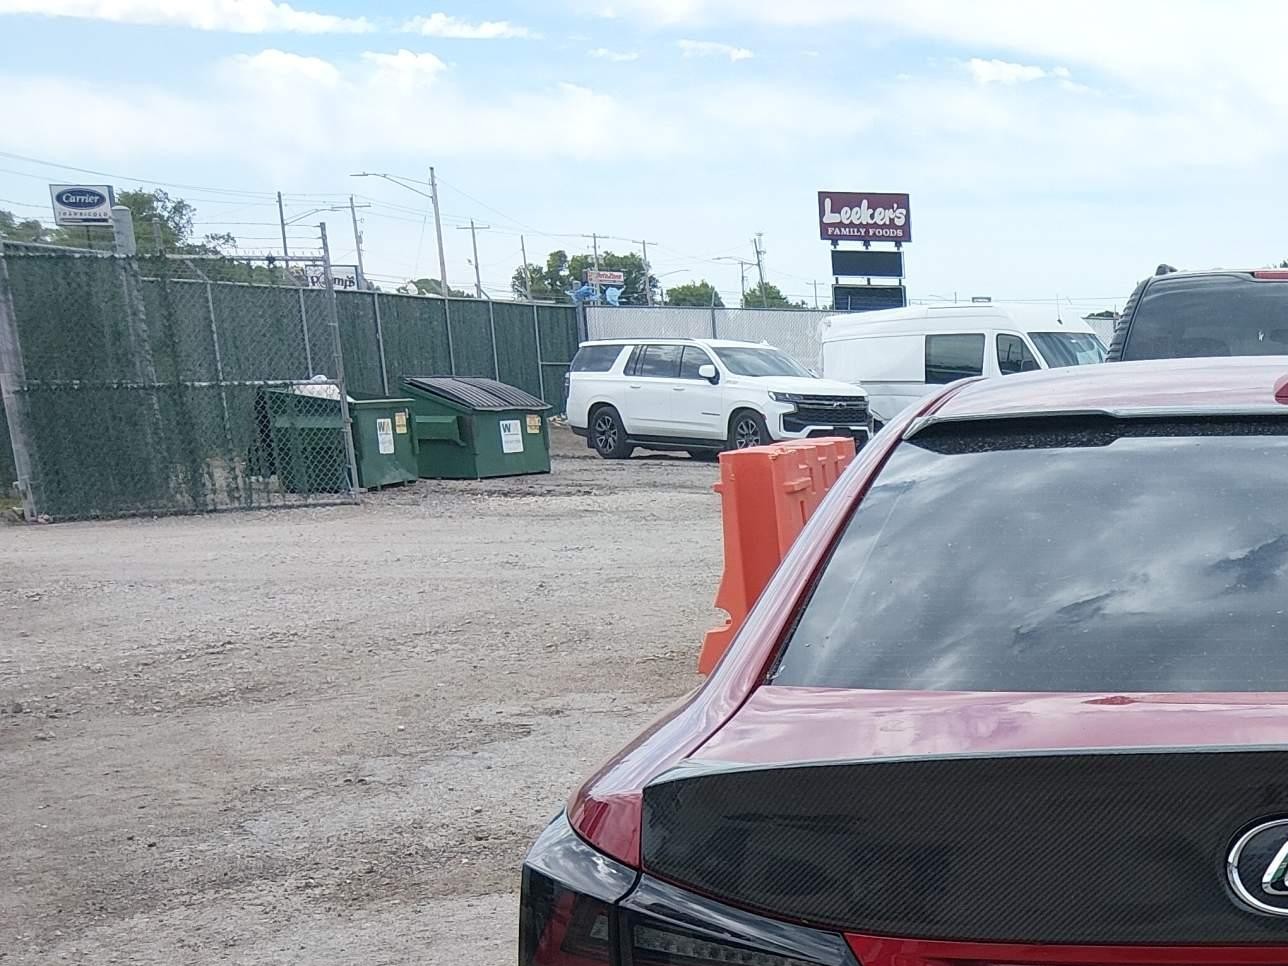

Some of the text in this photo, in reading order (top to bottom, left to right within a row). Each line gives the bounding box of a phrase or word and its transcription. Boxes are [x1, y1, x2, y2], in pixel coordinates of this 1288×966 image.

[62, 193, 99, 204] Carrier
[822, 198, 907, 226] Leeker's
[827, 227, 903, 237] FAMILY FOODS
